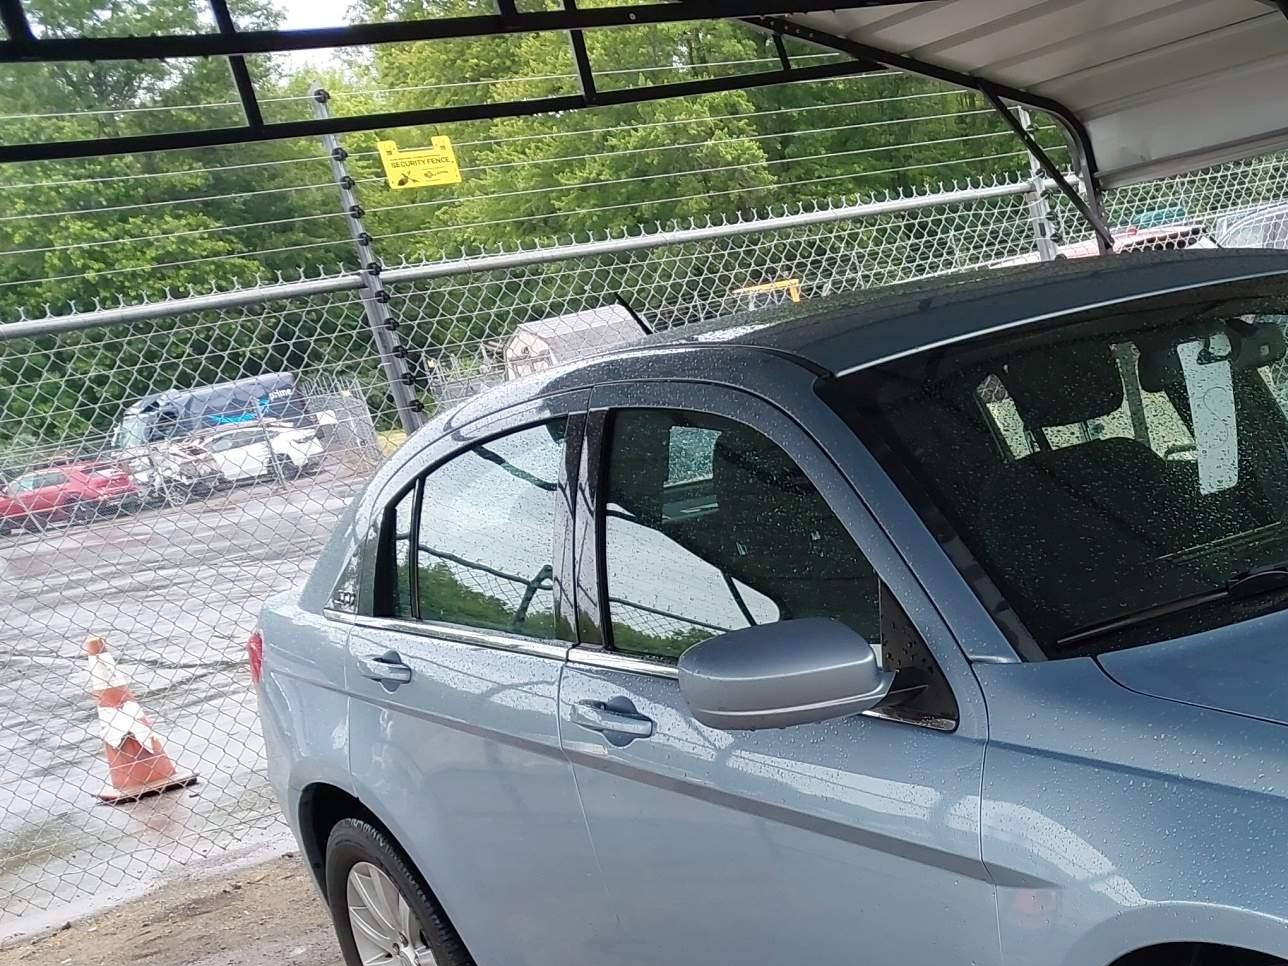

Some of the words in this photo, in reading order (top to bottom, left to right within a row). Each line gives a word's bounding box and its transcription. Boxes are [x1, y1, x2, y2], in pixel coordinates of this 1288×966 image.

[391, 158, 426, 168] SECURITY
[427, 156, 450, 165] FENCE
[269, 388, 292, 401] prime
